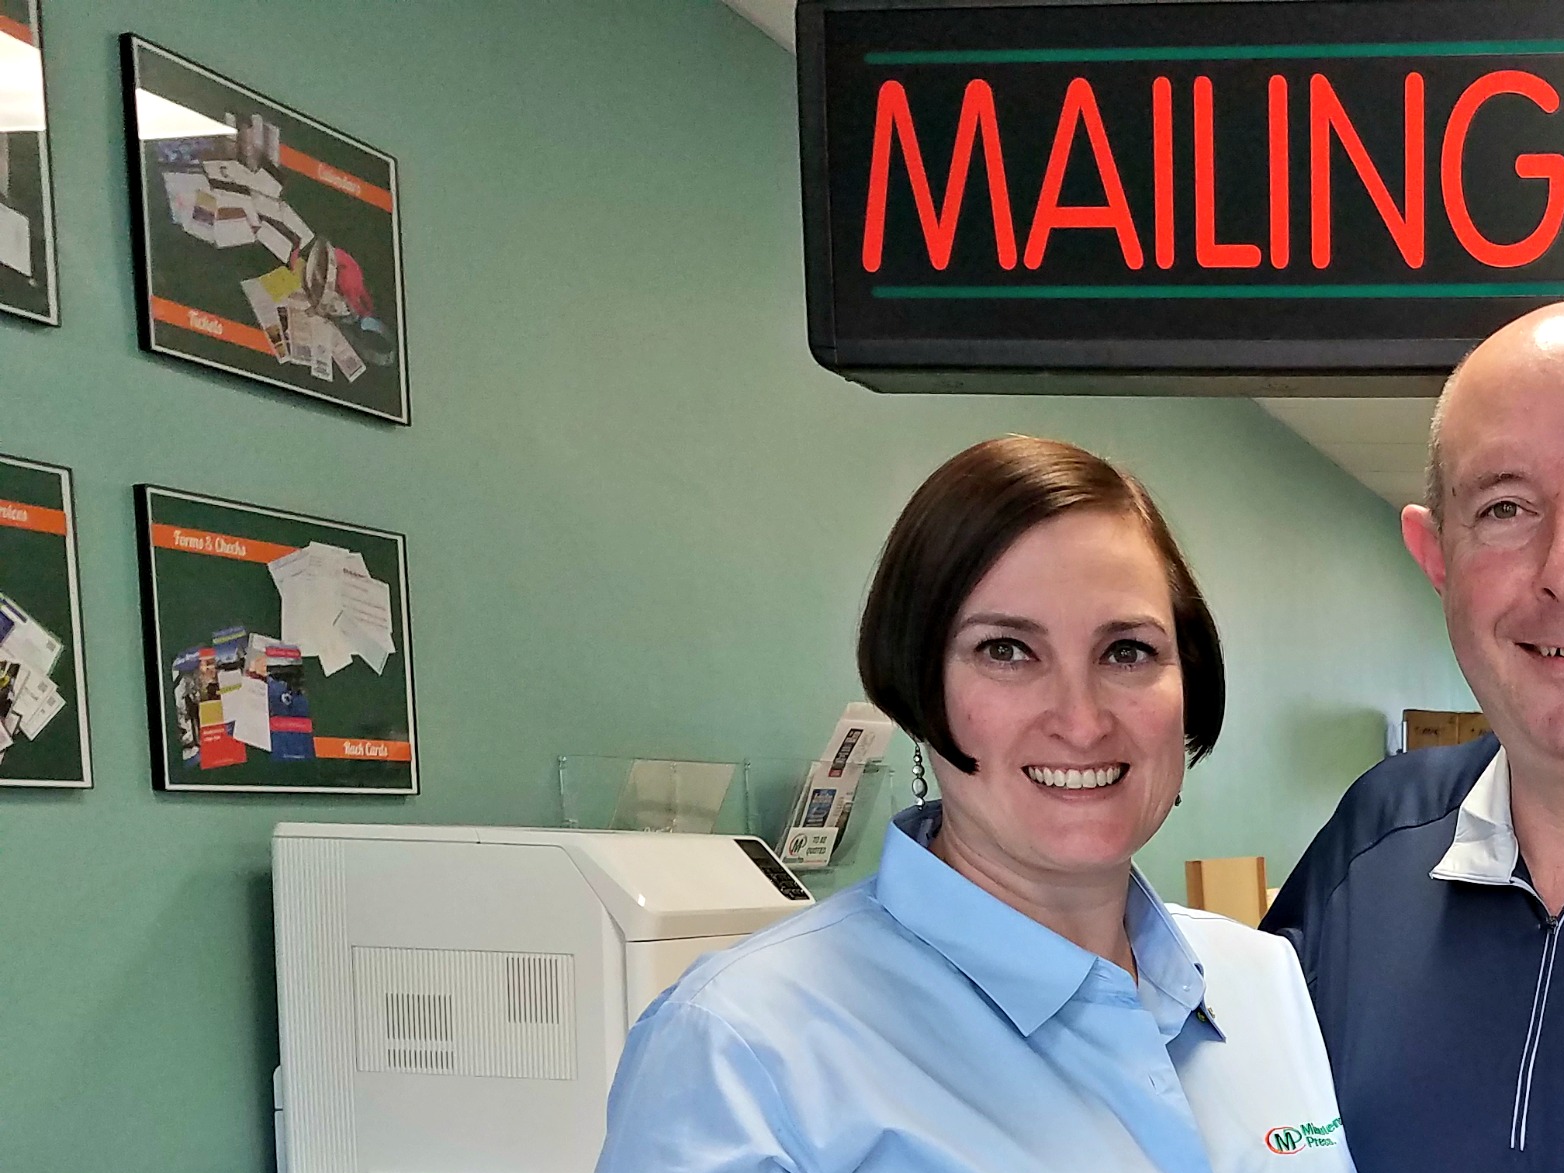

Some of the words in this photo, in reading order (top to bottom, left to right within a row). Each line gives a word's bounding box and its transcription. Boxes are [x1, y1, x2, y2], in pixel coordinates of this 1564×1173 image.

[173, 530, 203, 550] Forms
[215, 539, 247, 556] Checks
[343, 742, 364, 756] Rack
[365, 743, 388, 757] Cards
